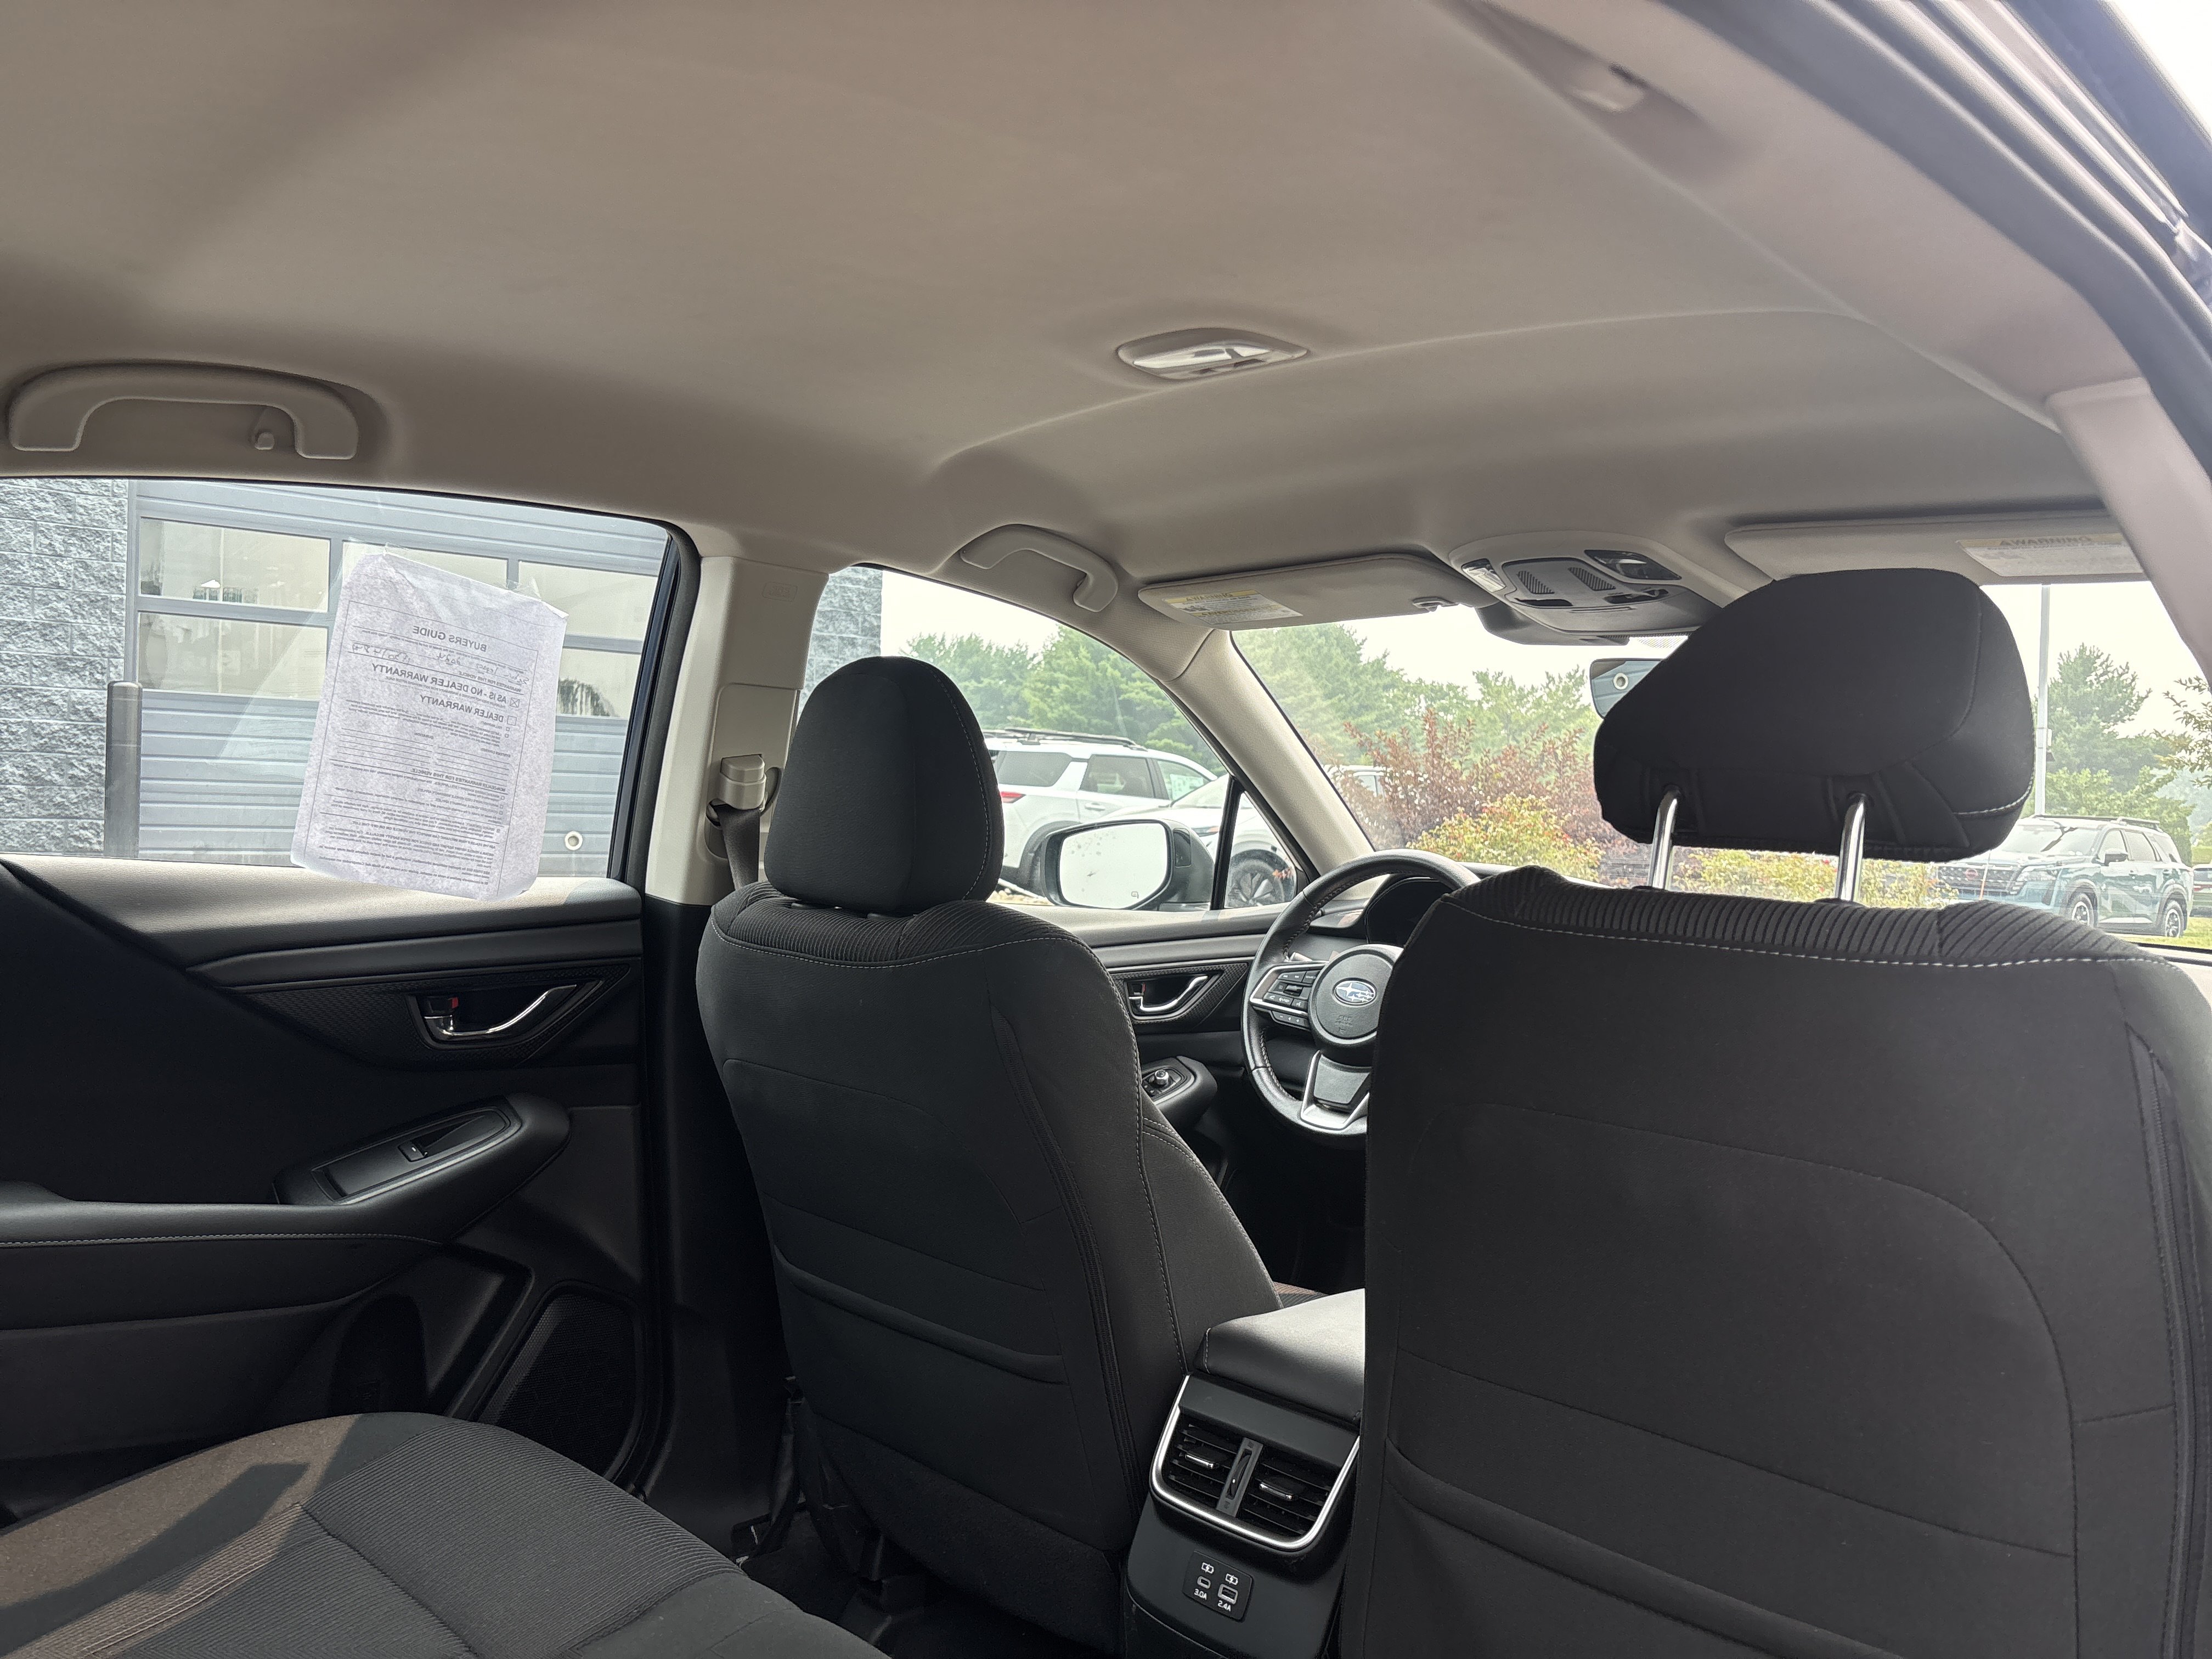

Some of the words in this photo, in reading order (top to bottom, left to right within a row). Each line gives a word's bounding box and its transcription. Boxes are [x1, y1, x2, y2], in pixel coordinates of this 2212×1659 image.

[2013, 535, 2091, 545] WARNING
[1190, 592, 1233, 602] WARNING
[1194, 1588, 1207, 1600] 3.0A
[1217, 1600, 1232, 1612] 2.4A
